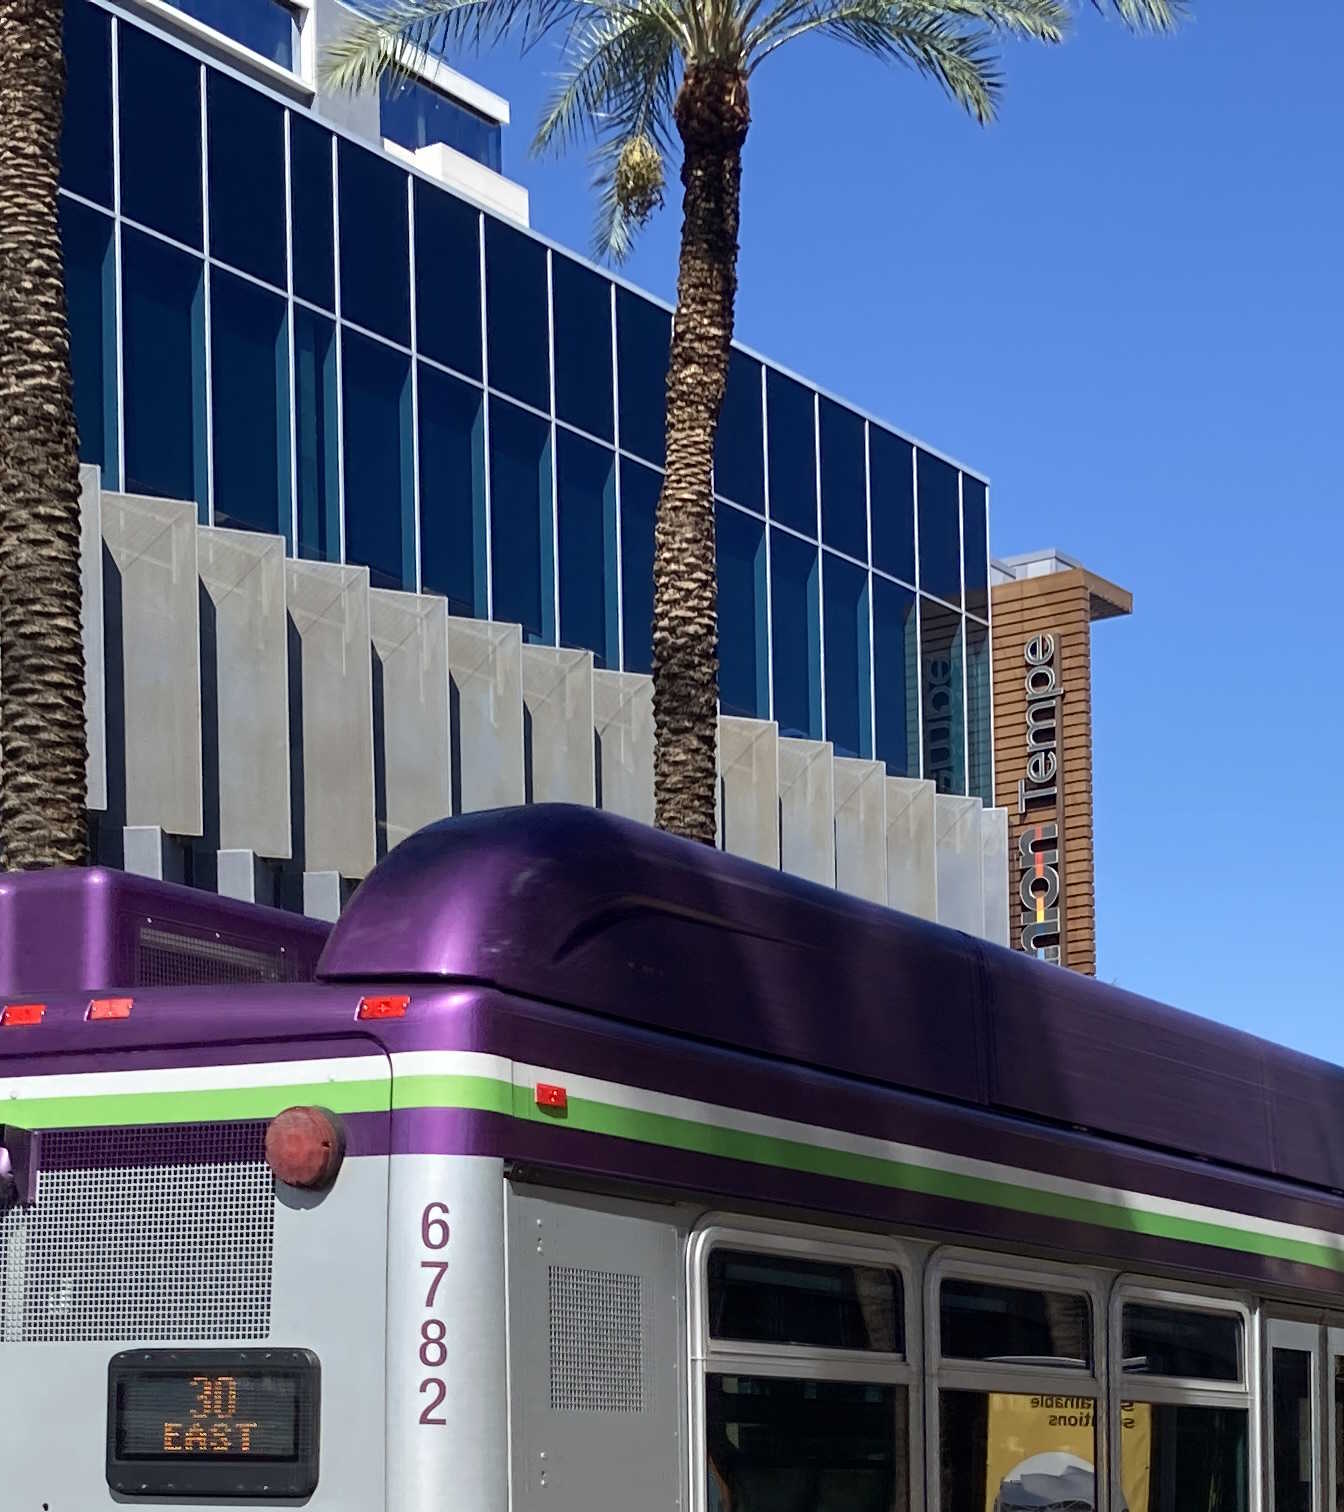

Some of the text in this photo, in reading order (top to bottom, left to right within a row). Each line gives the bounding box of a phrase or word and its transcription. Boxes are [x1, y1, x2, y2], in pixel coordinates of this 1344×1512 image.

[1018, 633, 1064, 814] Tempe
[418, 1201, 450, 1425] 6782
[164, 1422, 258, 1453] EAST
[190, 1377, 238, 1419] 30
